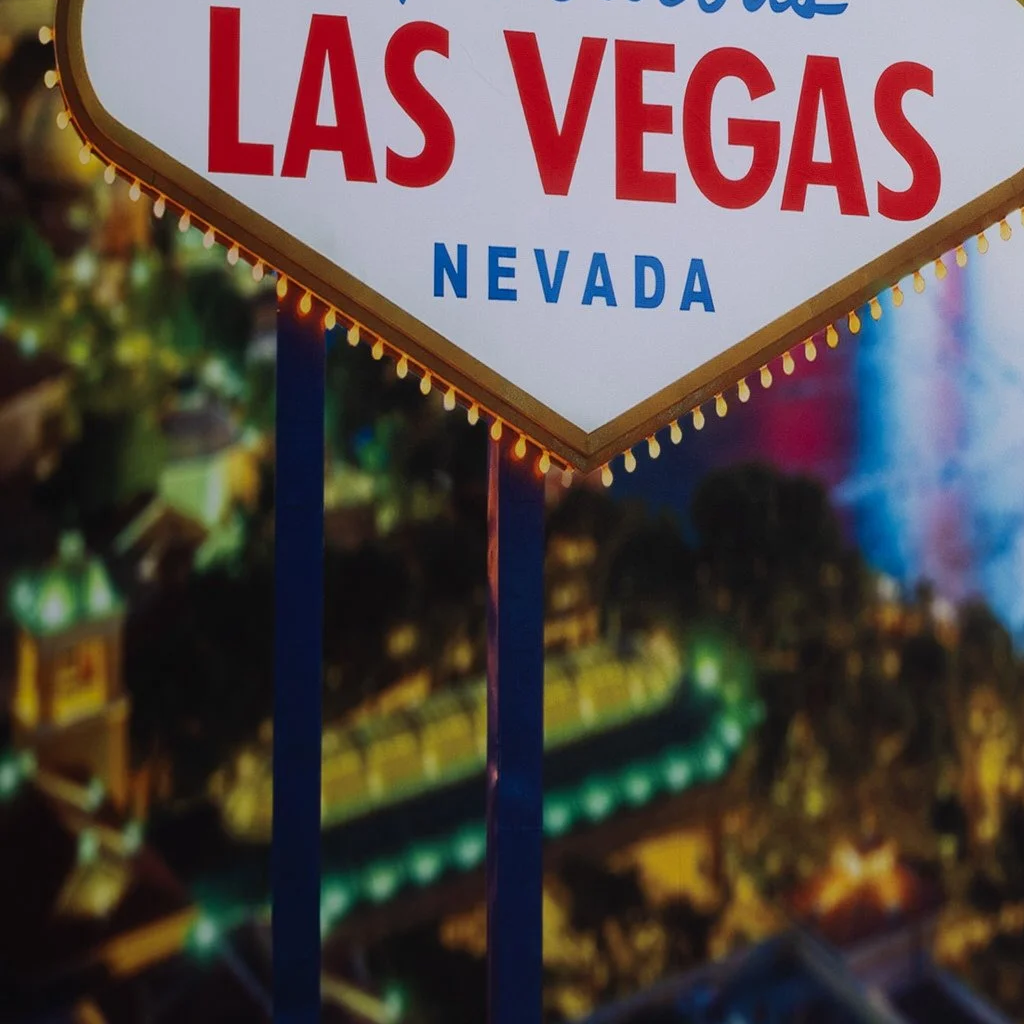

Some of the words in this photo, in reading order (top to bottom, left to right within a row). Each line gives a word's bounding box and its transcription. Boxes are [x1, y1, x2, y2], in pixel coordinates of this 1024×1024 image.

[207, 5, 456, 188] LAS
[503, 29, 942, 222] VEGAS
[432, 240, 716, 314] NEVADA
